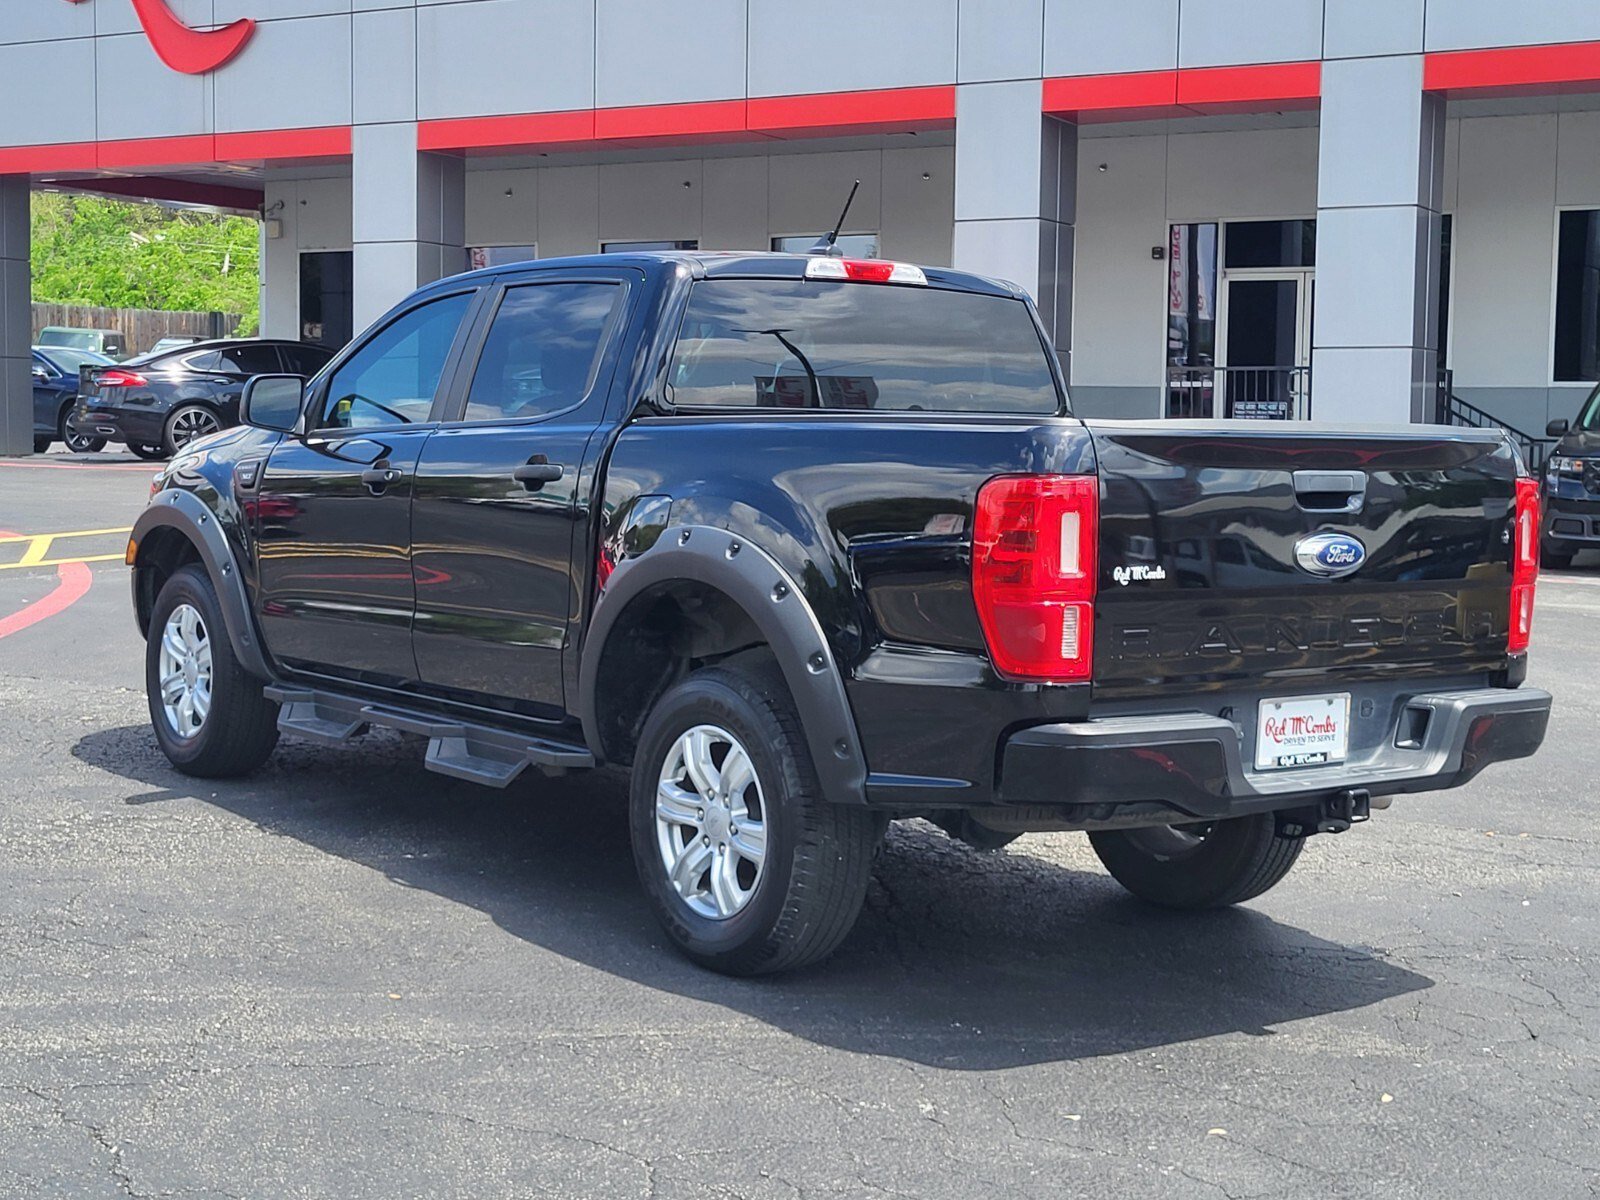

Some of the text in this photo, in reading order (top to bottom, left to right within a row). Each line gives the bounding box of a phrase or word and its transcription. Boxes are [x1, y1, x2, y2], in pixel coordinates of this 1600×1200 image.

[1326, 544, 1355, 563] Ford
[1113, 566, 1130, 586] Red
[1265, 715, 1336, 743] Red McCombs
[1283, 734, 1335, 745] DRIVEN TO SERVE
